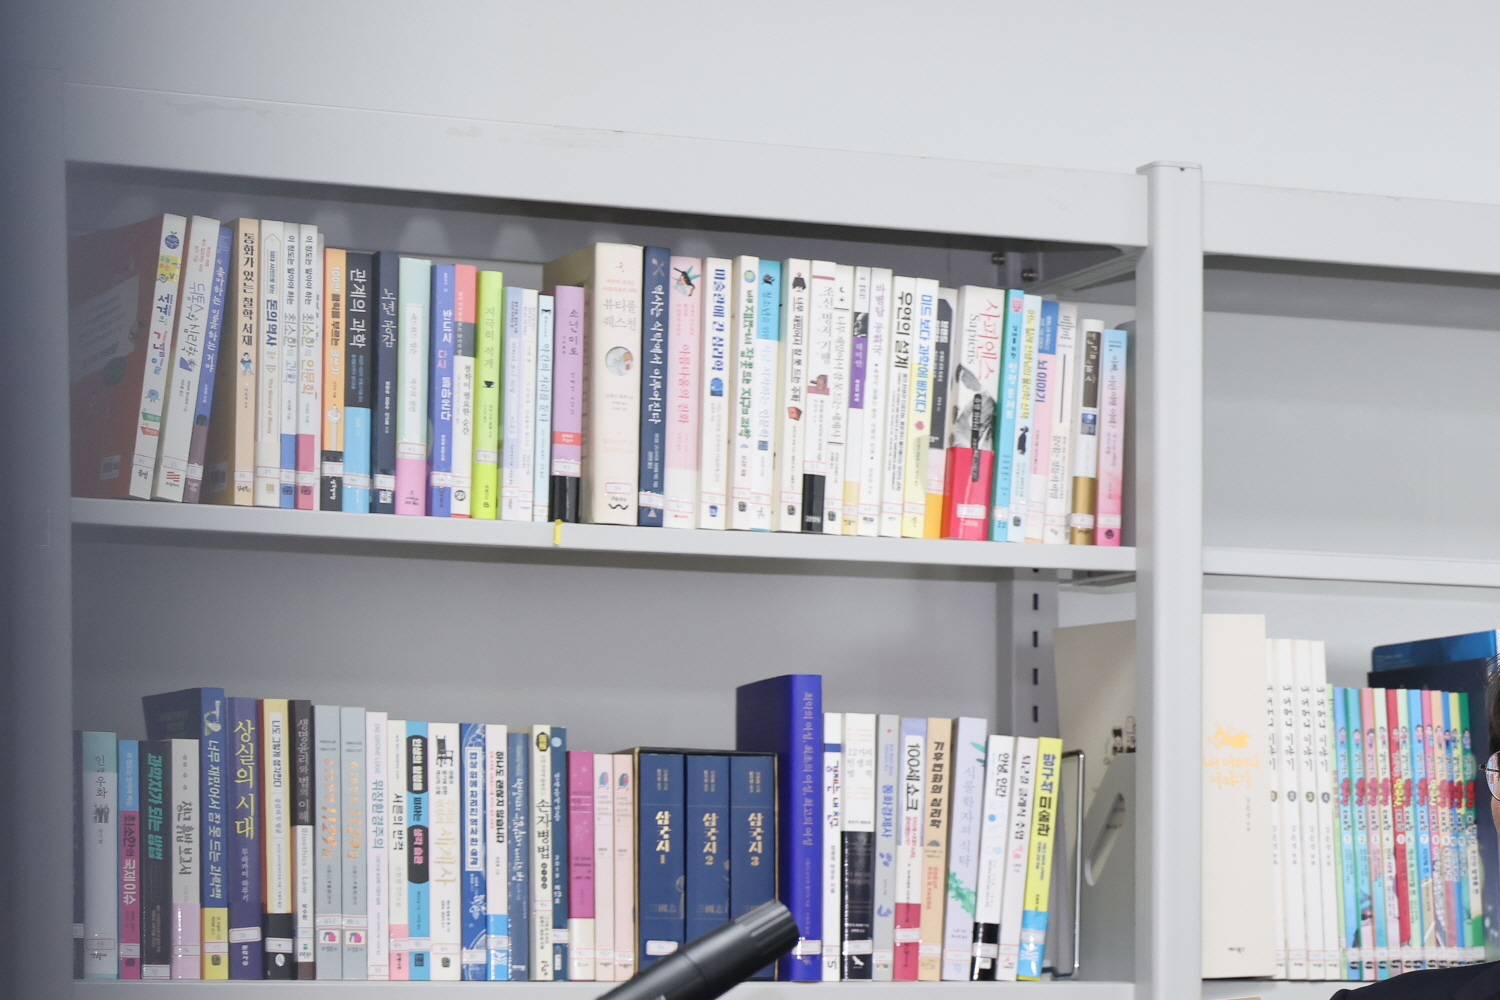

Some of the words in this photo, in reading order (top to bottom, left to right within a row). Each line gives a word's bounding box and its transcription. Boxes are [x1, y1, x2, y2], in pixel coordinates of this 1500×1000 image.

[243, 232, 255, 268] 동화가
[305, 235, 313, 243] 이
[305, 245, 313, 266] 정도는
[242, 270, 254, 294] 있는
[305, 267, 314, 290] 알아야
[349, 268, 367, 313] 관계의
[304, 290, 313, 306] 하는
[650, 284, 665, 318] 역사는
[713, 268, 726, 318] 미술관에
[919, 294, 933, 316] 미드
[242, 297, 253, 321] 철학
[894, 291, 913, 336] 우연의
[241, 322, 253, 347] 서재
[301, 313, 315, 357] 최소한의
[349, 317, 367, 349] 과학
[441, 309, 452, 344] 반드시
[484, 306, 496, 341] 지극히
[712, 320, 725, 333] 간
[918, 318, 932, 341] 보다
[649, 320, 663, 365] 식탁에서
[964, 313, 980, 365] Sapiens
[977, 298, 1000, 382] 사피엔스
[436, 349, 447, 369] 다시
[483, 346, 494, 369] 적게
[711, 336, 724, 371] 심리학
[893, 339, 910, 369] 설계
[916, 344, 931, 378] 과학에
[1036, 359, 1048, 370] 뇌
[301, 359, 315, 395] 인문학
[677, 344, 691, 399] 아름다움의
[440, 377, 452, 421] 돌아온다
[647, 368, 662, 425] 이루어진다
[914, 380, 929, 414] 빠지다
[1034, 371, 1047, 403] 이야기
[677, 402, 690, 424] 진화
[207, 740, 221, 763] 너무
[233, 719, 256, 789] 상실의
[412, 738, 423, 764] 인생의
[495, 751, 505, 777] 하나도
[995, 752, 1010, 776] 안녕,
[147, 753, 163, 804] 과학자가
[826, 760, 841, 794] 경제는
[1019, 755, 1032, 785] 퇴근길
[207, 764, 221, 809] 재밌어서
[495, 779, 505, 807] 괜찮지
[995, 777, 1010, 798] 인간
[234, 792, 255, 840] 시대
[371, 779, 385, 849] 위장환경주의
[412, 796, 422, 822] 피하는
[832, 797, 840, 808] 내
[881, 784, 895, 838] 동화경제사
[1016, 787, 1029, 817] 클래식
[148, 806, 163, 832] 되는
[208, 812, 221, 825] 잠
[208, 826, 221, 838] 못
[495, 809, 505, 843] 않습니다
[826, 810, 841, 829] 친구
[1013, 820, 1027, 840] 수업
[148, 833, 163, 860] 방법
[301, 828, 309, 867] Bioethics
[413, 828, 424, 845] 생각
[208, 839, 221, 863] 드는
[413, 846, 424, 865] 습관
[704, 855, 715, 866] 2
[749, 855, 760, 867] 3
[209, 864, 222, 899] 과학책
[301, 876, 309, 894] Law
